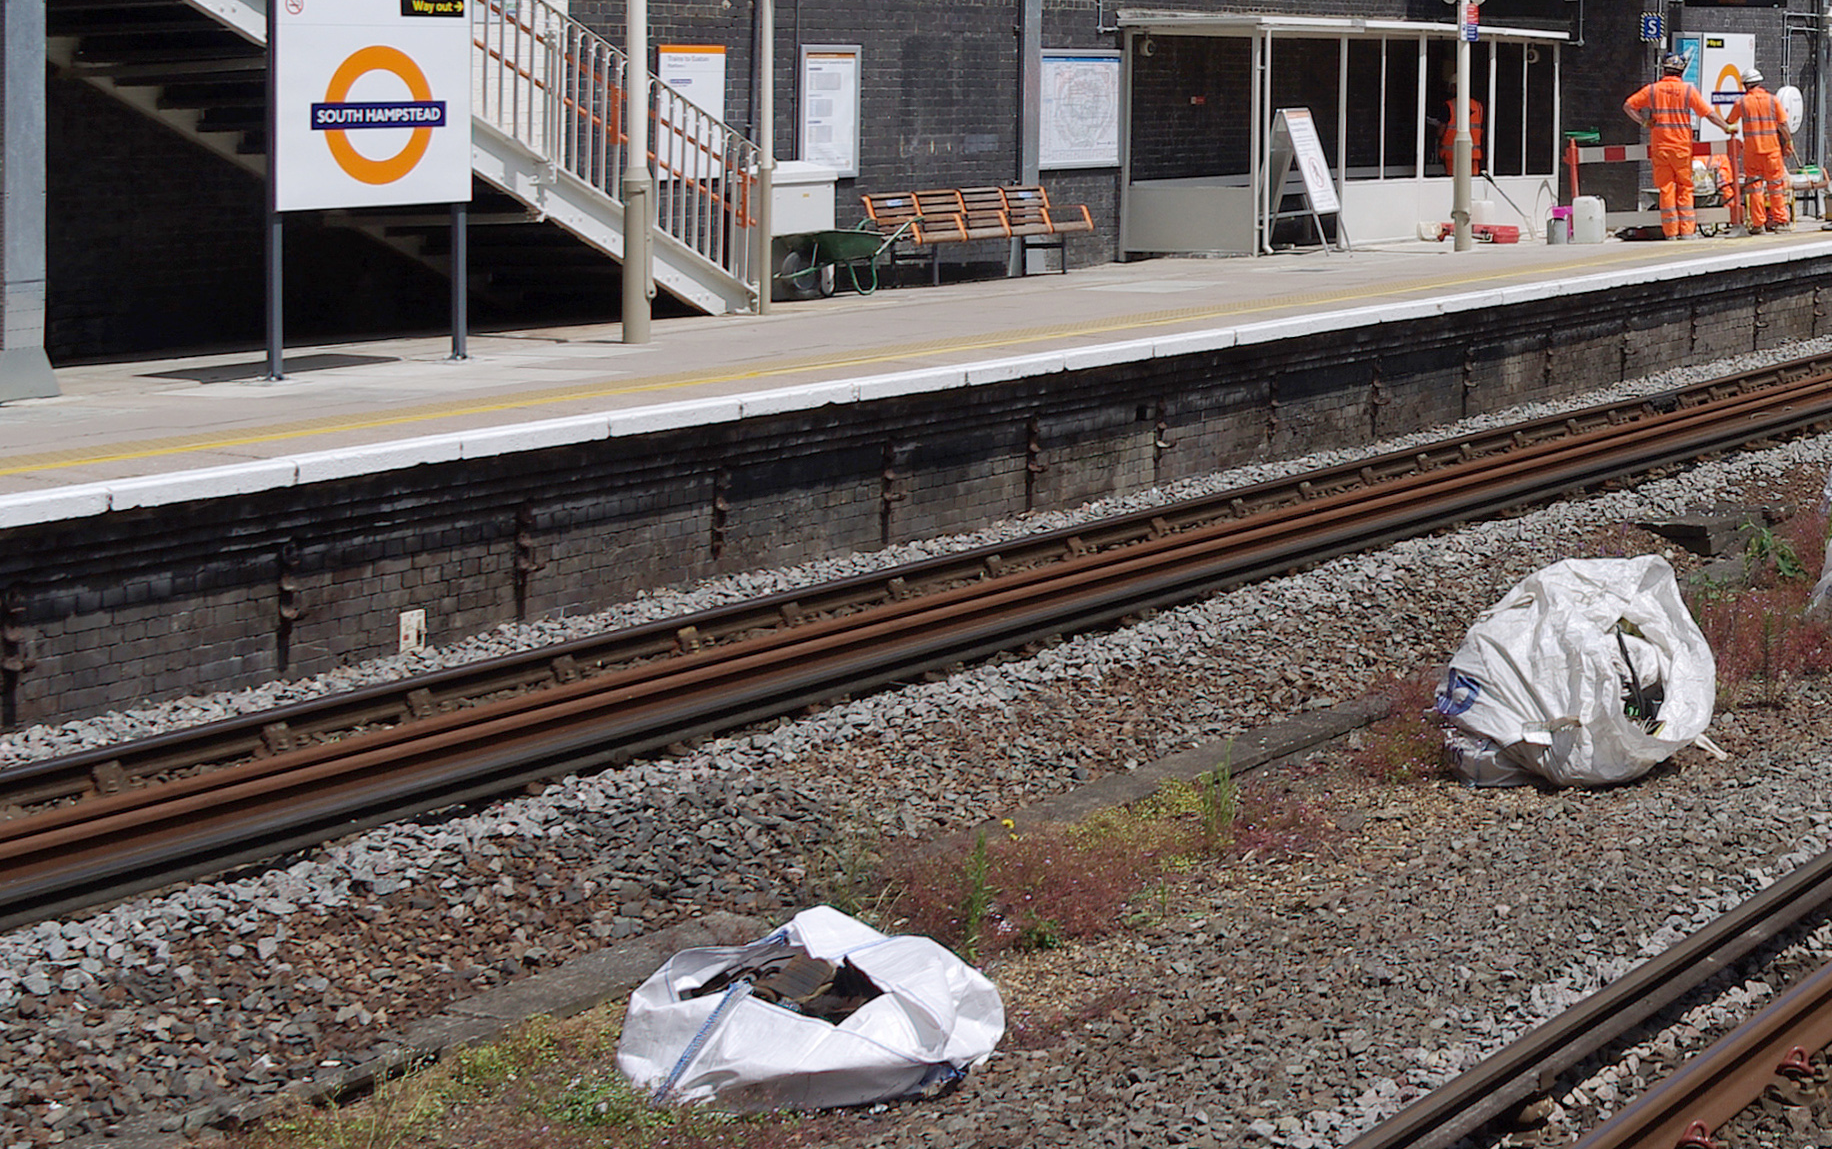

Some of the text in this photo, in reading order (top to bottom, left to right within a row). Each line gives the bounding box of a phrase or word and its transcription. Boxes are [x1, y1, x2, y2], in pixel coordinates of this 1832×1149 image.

[412, 0, 453, 14] Way out
[1647, 19, 1657, 35] S
[316, 106, 442, 124] SOUTH HAMPSTEAD
